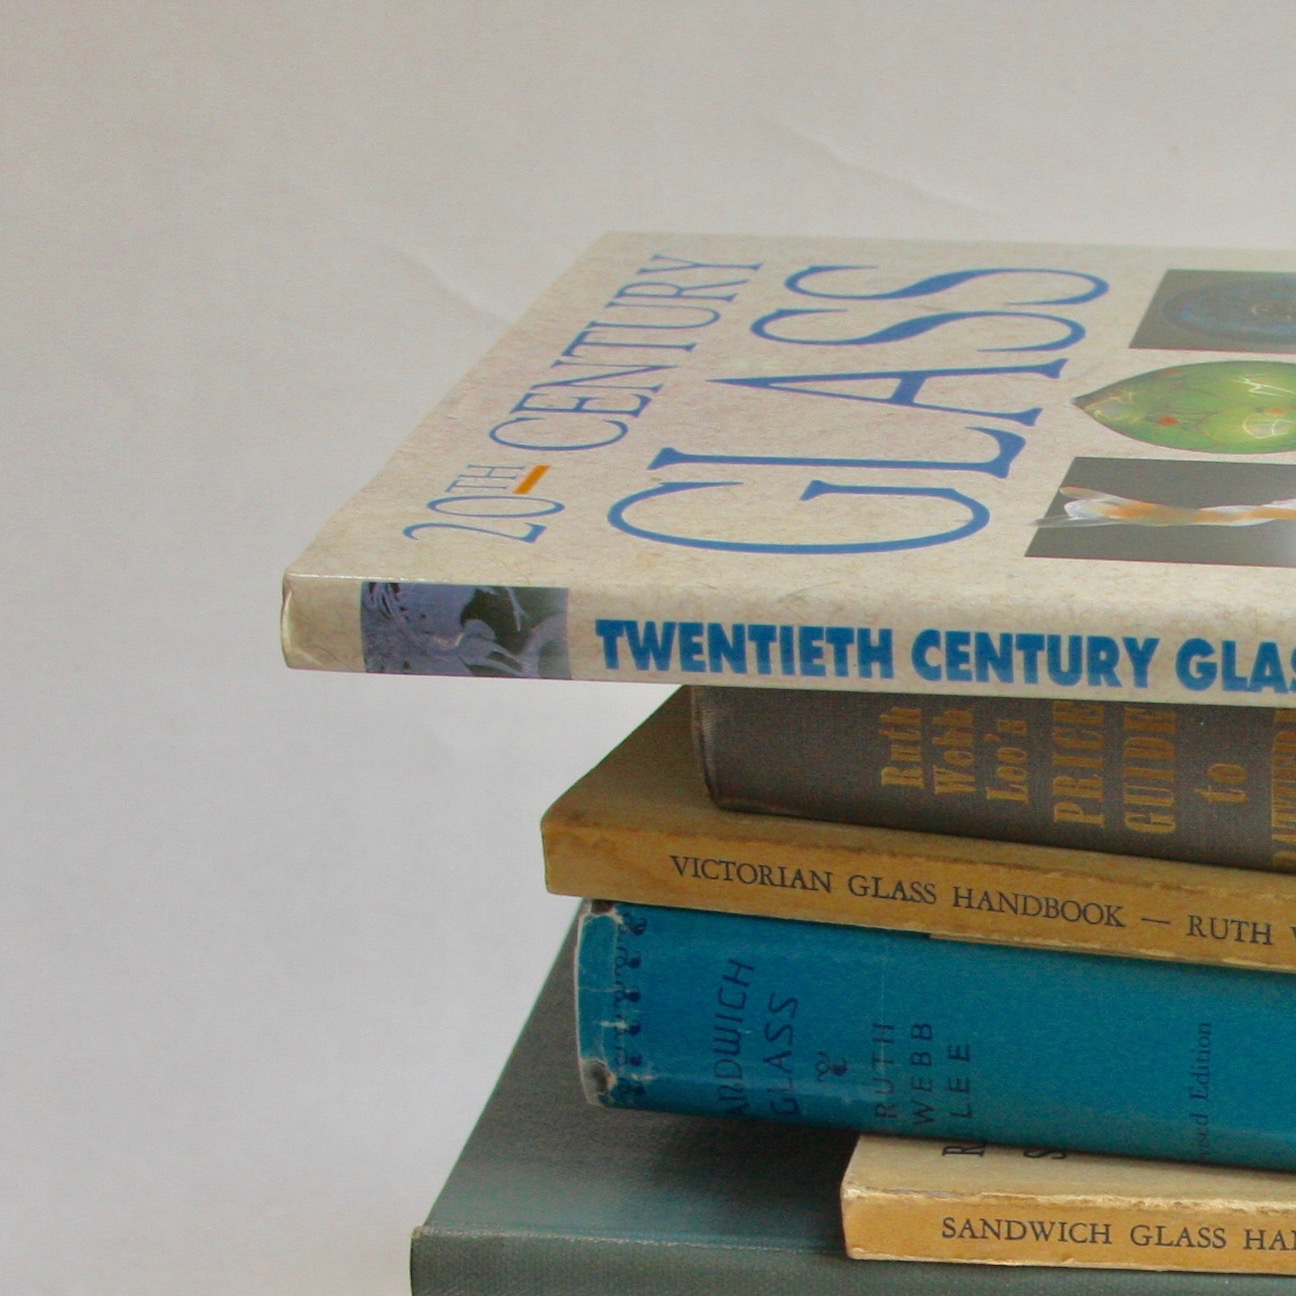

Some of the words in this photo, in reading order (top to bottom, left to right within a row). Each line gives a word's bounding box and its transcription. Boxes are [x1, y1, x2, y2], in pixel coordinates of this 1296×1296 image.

[488, 254, 763, 451] CENTURY
[607, 265, 1110, 554] GLASS
[596, 619, 893, 681] TWENTIETH
[911, 629, 1159, 692] CENTURY
[881, 705, 925, 791] Ruth
[932, 708, 976, 797] Webb
[1052, 700, 1106, 831] PRICE
[1121, 708, 1179, 836] GUIDE
[1194, 762, 1247, 805] to
[670, 855, 833, 895] VICTORIAN
[847, 873, 938, 905] GLASS
[952, 886, 1126, 929] HANDBOOK
[1186, 914, 1274, 946] RUTH
[712, 956, 756, 1120] ANDWICH
[765, 991, 798, 1118] GLASS
[911, 1020, 935, 1126] WEBB
[946, 1041, 973, 1120] LEE
[941, 1217, 1112, 1245] SANDWICH
[1130, 1224, 1228, 1249] GLASS
